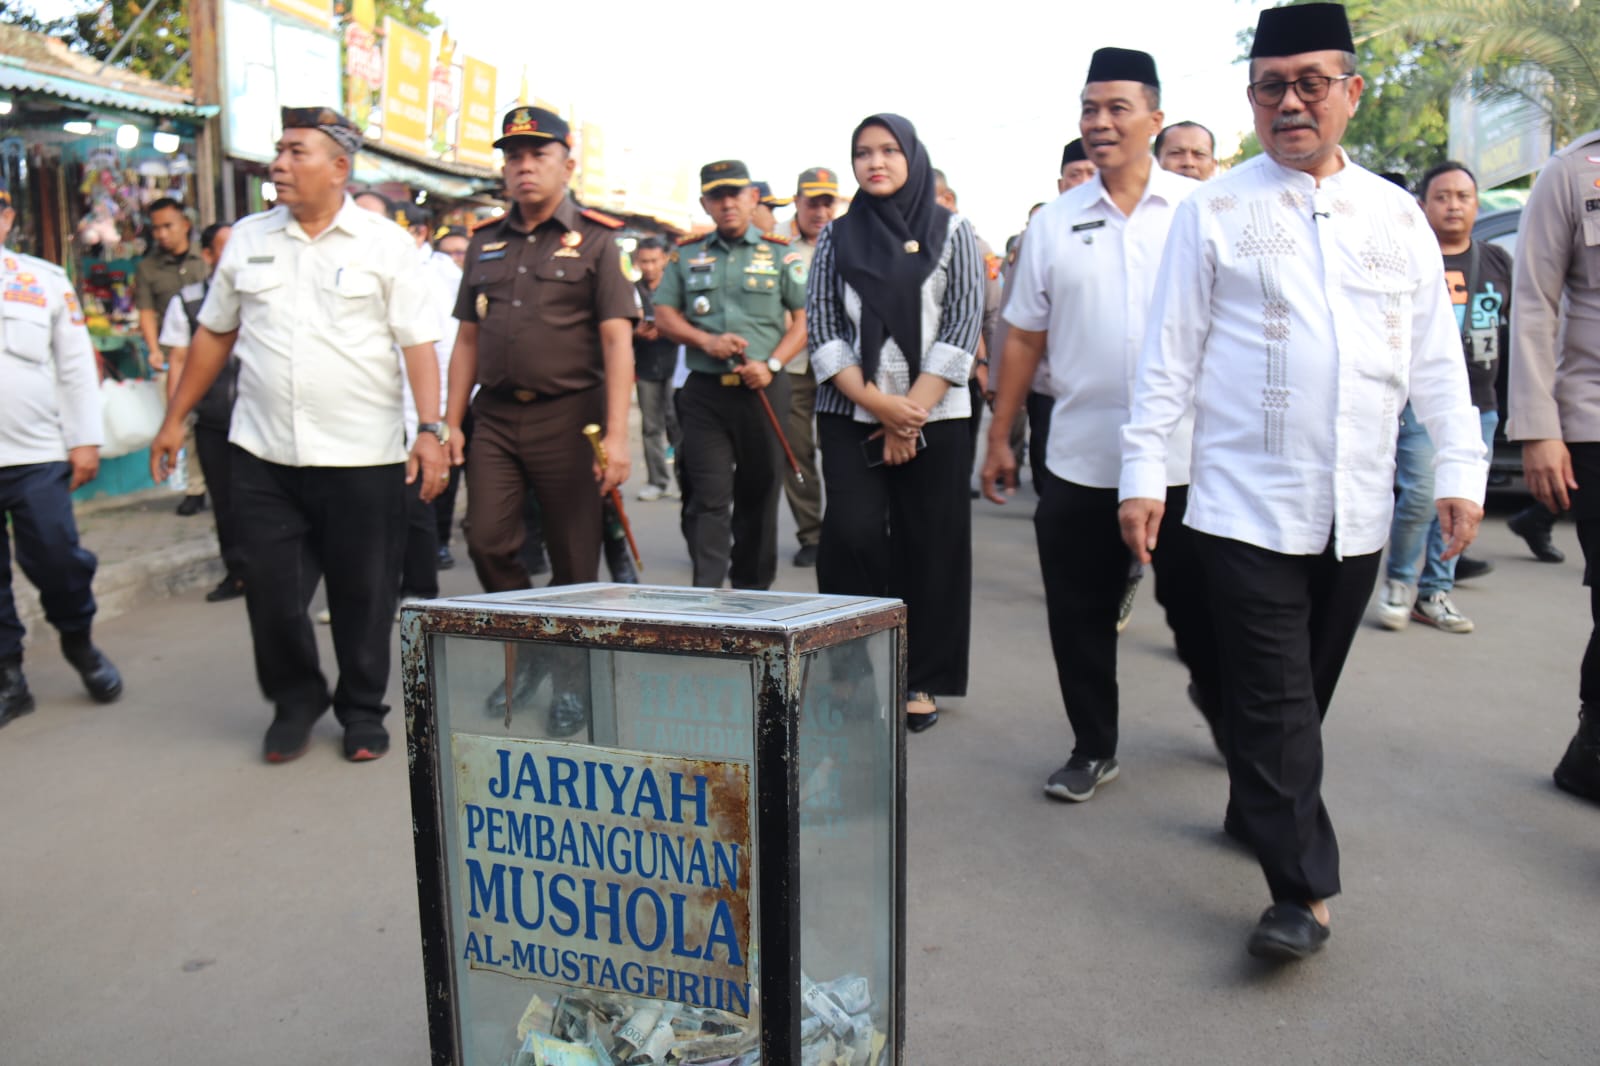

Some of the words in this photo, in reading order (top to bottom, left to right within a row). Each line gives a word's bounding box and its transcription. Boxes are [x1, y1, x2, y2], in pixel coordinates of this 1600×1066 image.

[488, 749, 708, 827] JARIYAH
[465, 804, 739, 892] PEMBANGUNAN
[465, 859, 744, 966] MUSHOLA
[463, 931, 751, 1016] AL-MUSTAGFIRIIN
